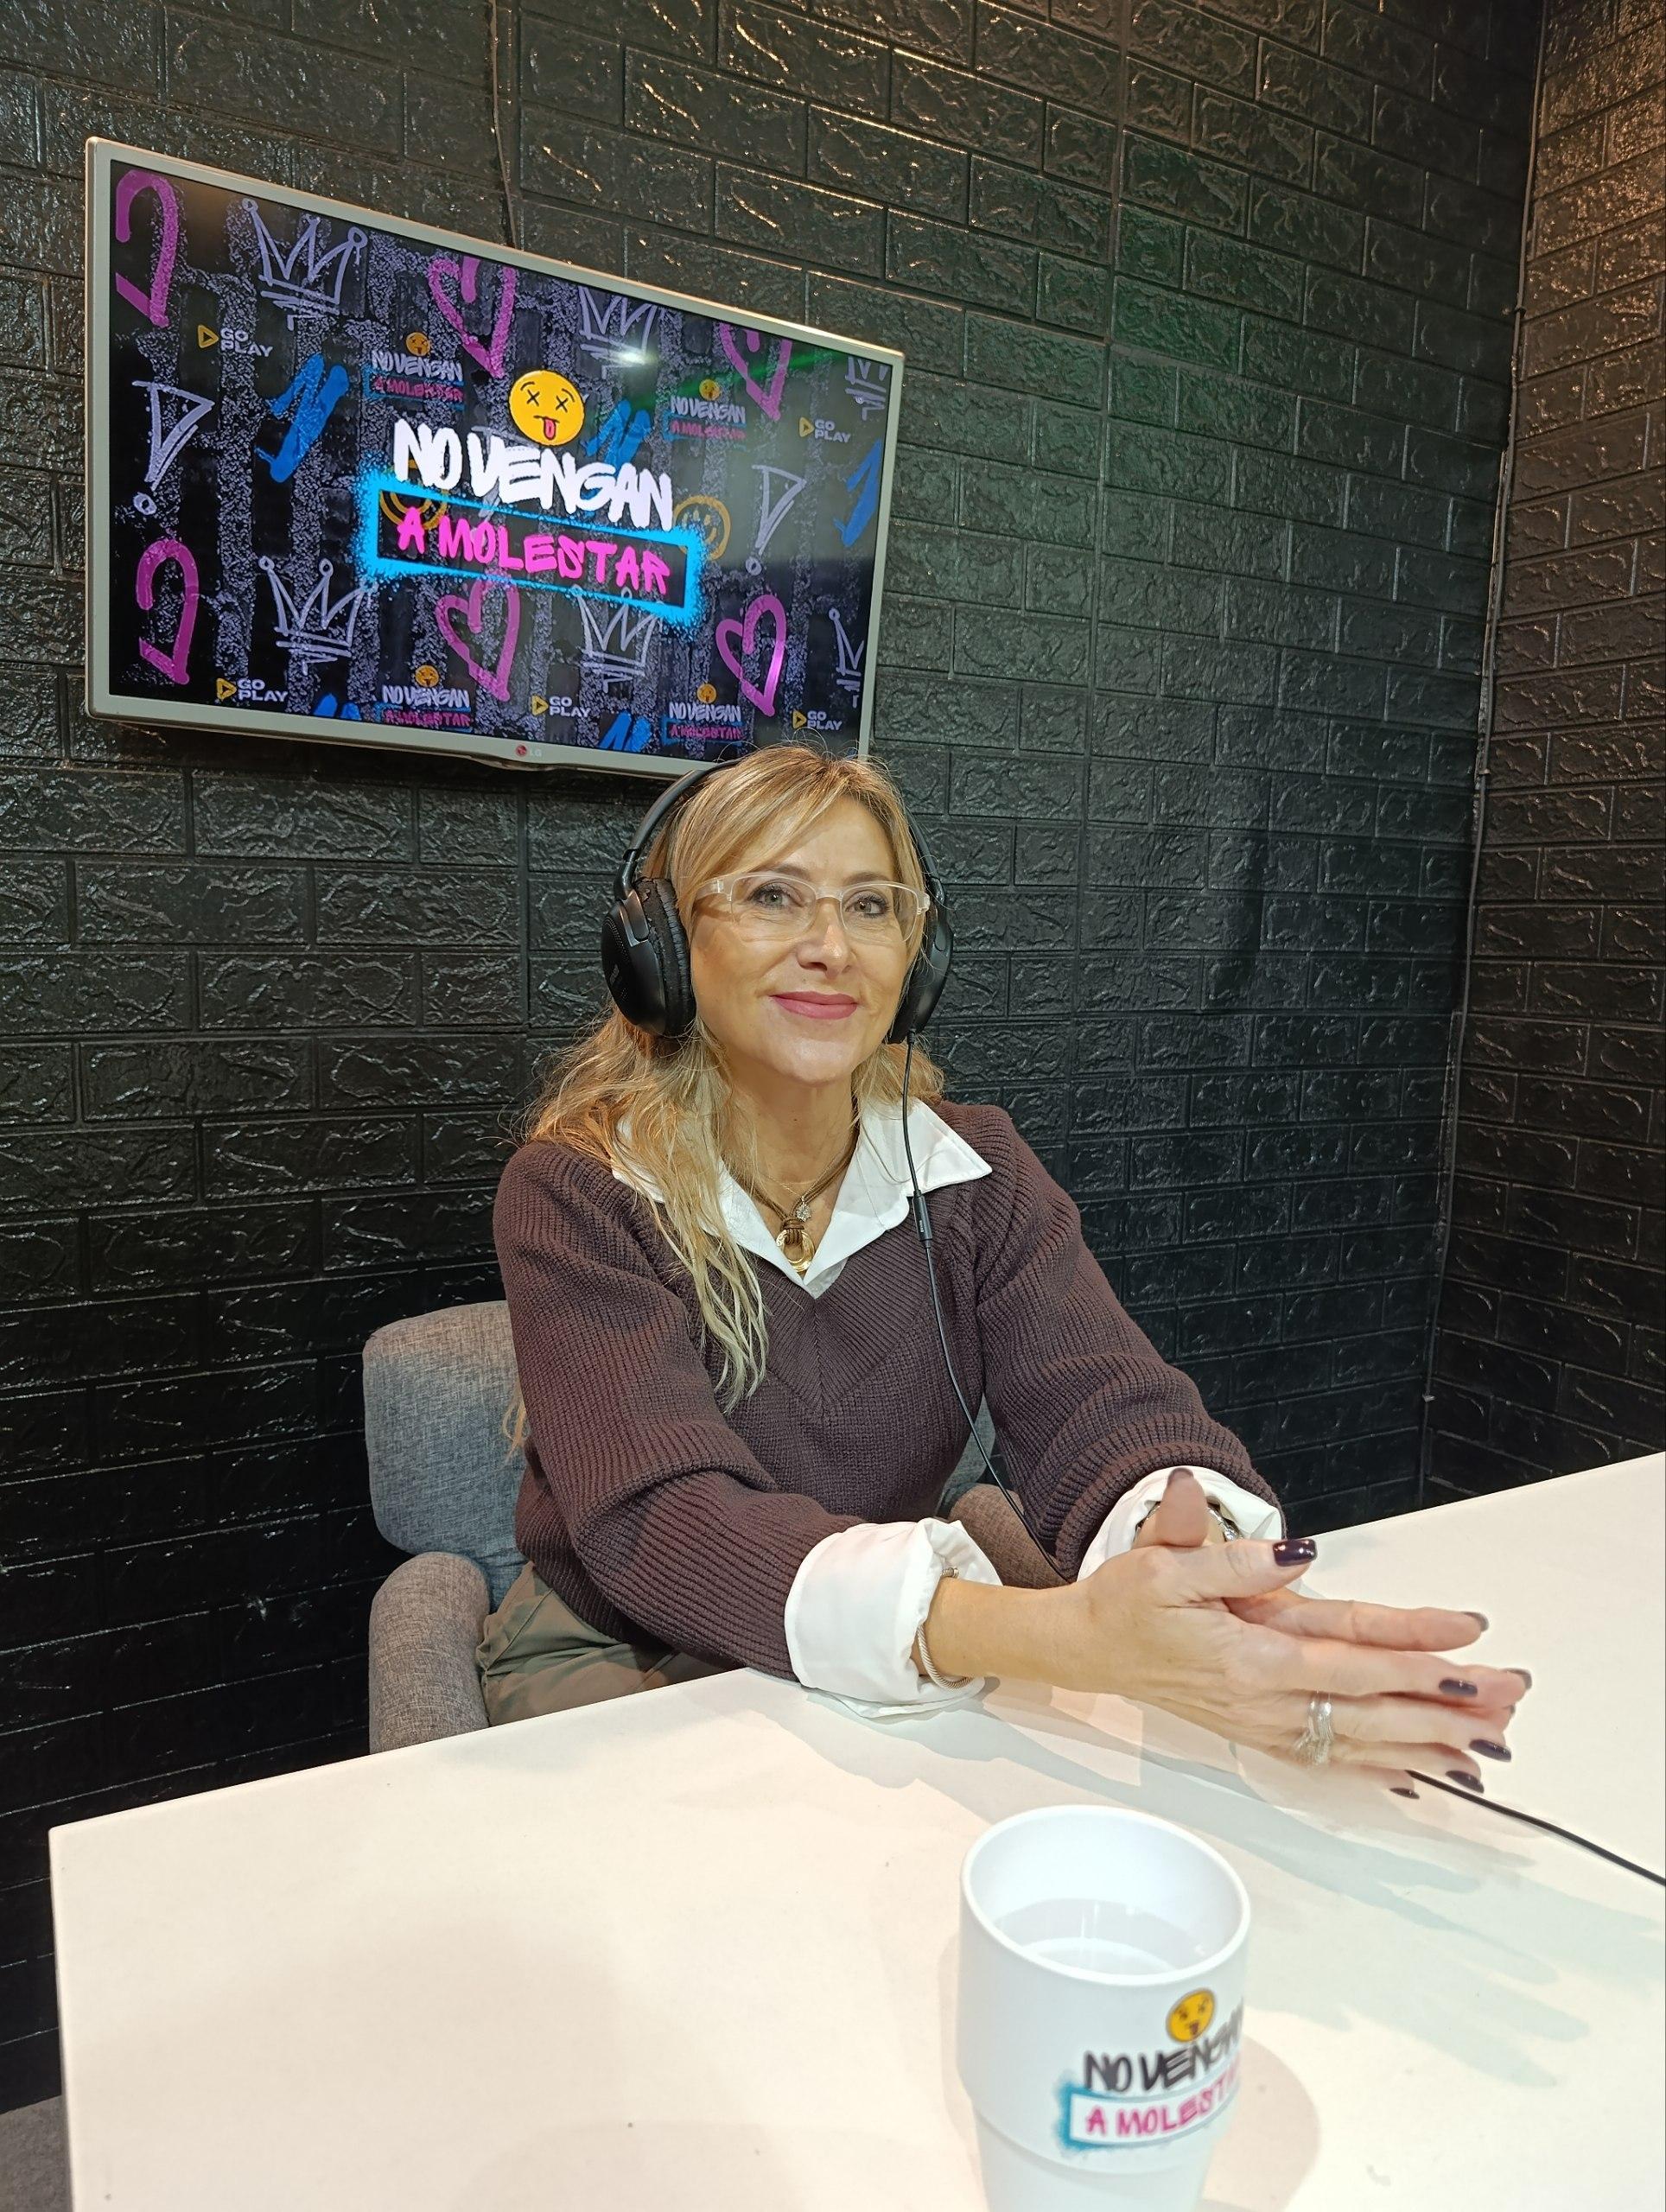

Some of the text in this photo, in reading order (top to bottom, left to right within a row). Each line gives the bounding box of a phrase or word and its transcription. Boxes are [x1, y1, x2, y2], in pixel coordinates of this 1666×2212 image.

[220, 327, 249, 342] GO
[220, 340, 273, 357] PLAY
[815, 419, 835, 430] GO
[815, 429, 851, 442] PLAY
[393, 418, 672, 531] NO VENGAN
[397, 506, 671, 595] A MOLESTAR
[237, 678, 265, 690] GO
[238, 690, 288, 702] PLAY
[549, 696, 572, 707] GO
[550, 706, 590, 717] PLAY
[807, 710, 827, 721] GO
[807, 720, 843, 730] PLAY
[1085, 2050, 1132, 2093] NO
[1086, 2052, 1241, 2137] A MOLEST
